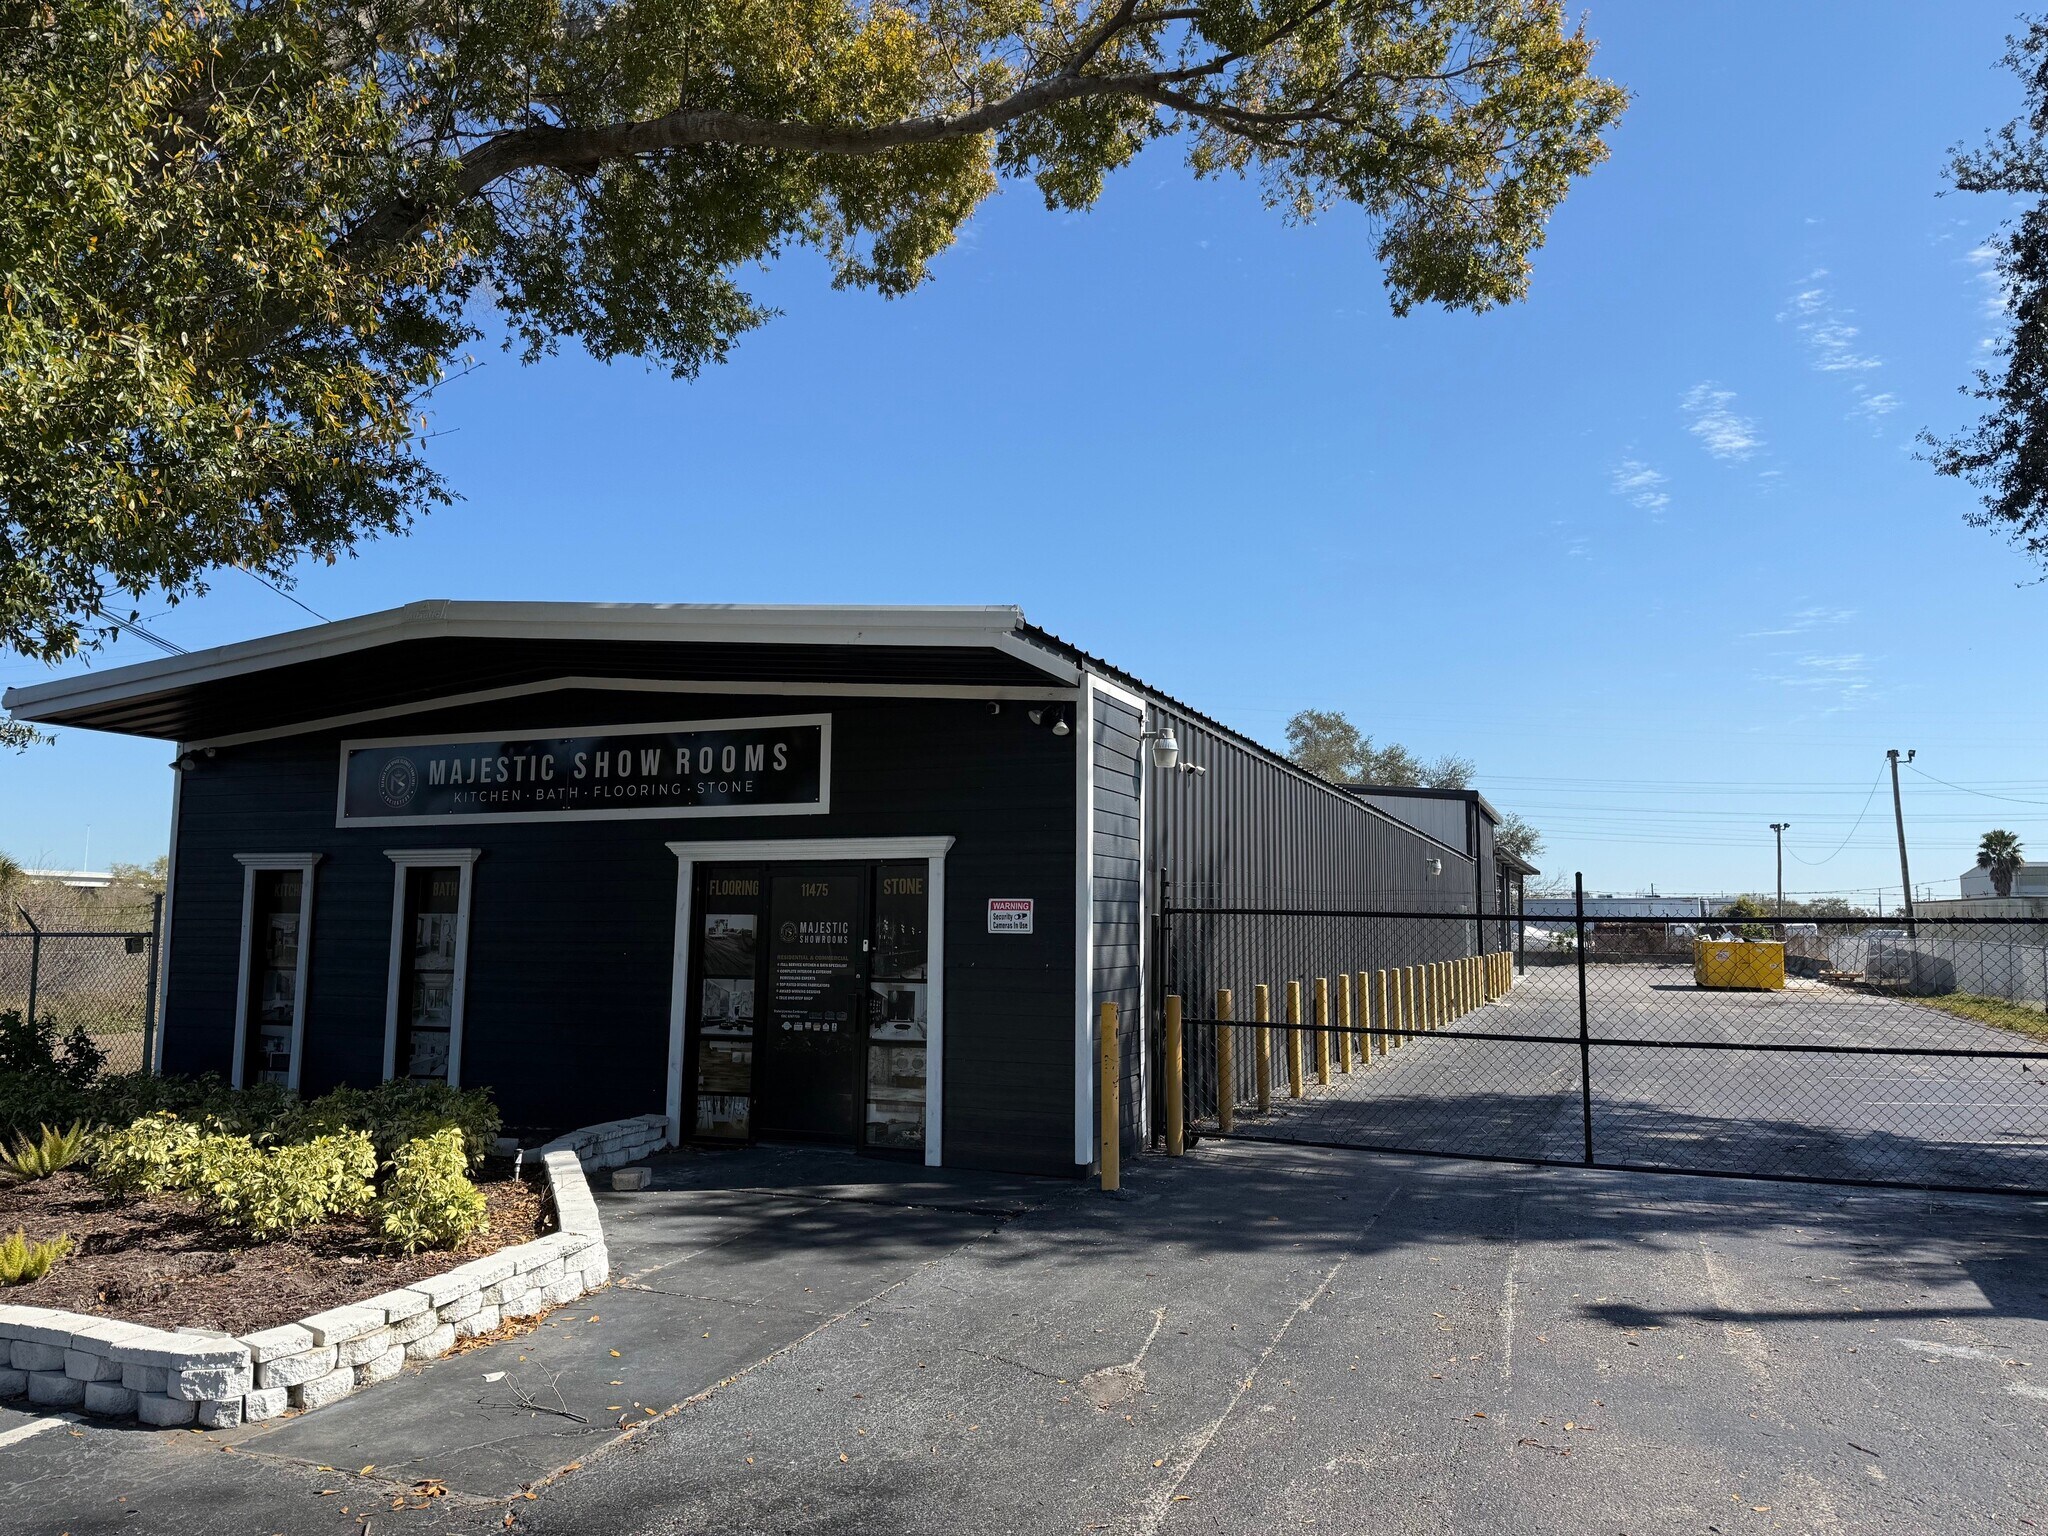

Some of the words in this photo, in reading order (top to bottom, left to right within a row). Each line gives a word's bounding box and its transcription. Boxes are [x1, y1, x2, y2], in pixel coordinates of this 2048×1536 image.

[429, 754, 555, 786] MAJESTIC
[573, 749, 661, 779] SHOW
[676, 743, 788, 775] ROOMS
[454, 789, 521, 803] KITCHEN
[536, 787, 578, 800] BATH
[594, 783, 681, 798] FLOORING
[697, 780, 754, 794] STONE
[432, 881, 458, 896] BATH
[709, 879, 760, 896] FLOORING
[801, 883, 829, 897] 11475
[883, 878, 923, 895] STONE
[992, 902, 1029, 910] WARNING
[993, 913, 1013, 921] Security
[799, 921, 849, 934] MAJESTIC
[799, 935, 848, 944] SHOWROOMS
